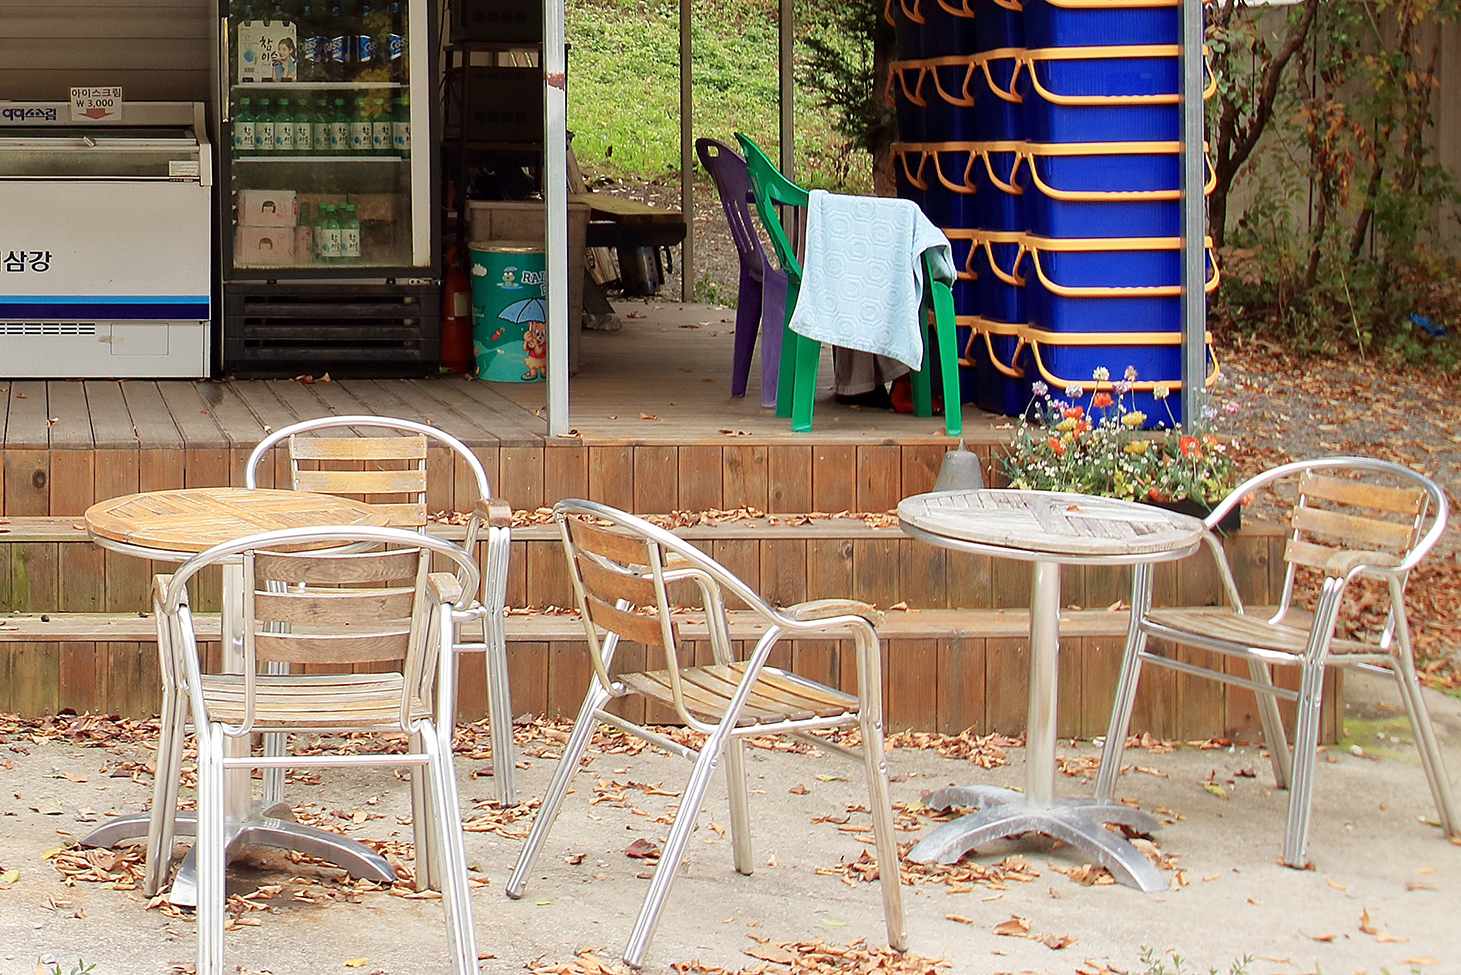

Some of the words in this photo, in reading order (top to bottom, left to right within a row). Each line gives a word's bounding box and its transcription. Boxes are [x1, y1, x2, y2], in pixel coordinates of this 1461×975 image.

[71, 88, 121, 98] 아이스크림
[87, 99, 114, 108] 3,000
[521, 270, 546, 285] RAI
